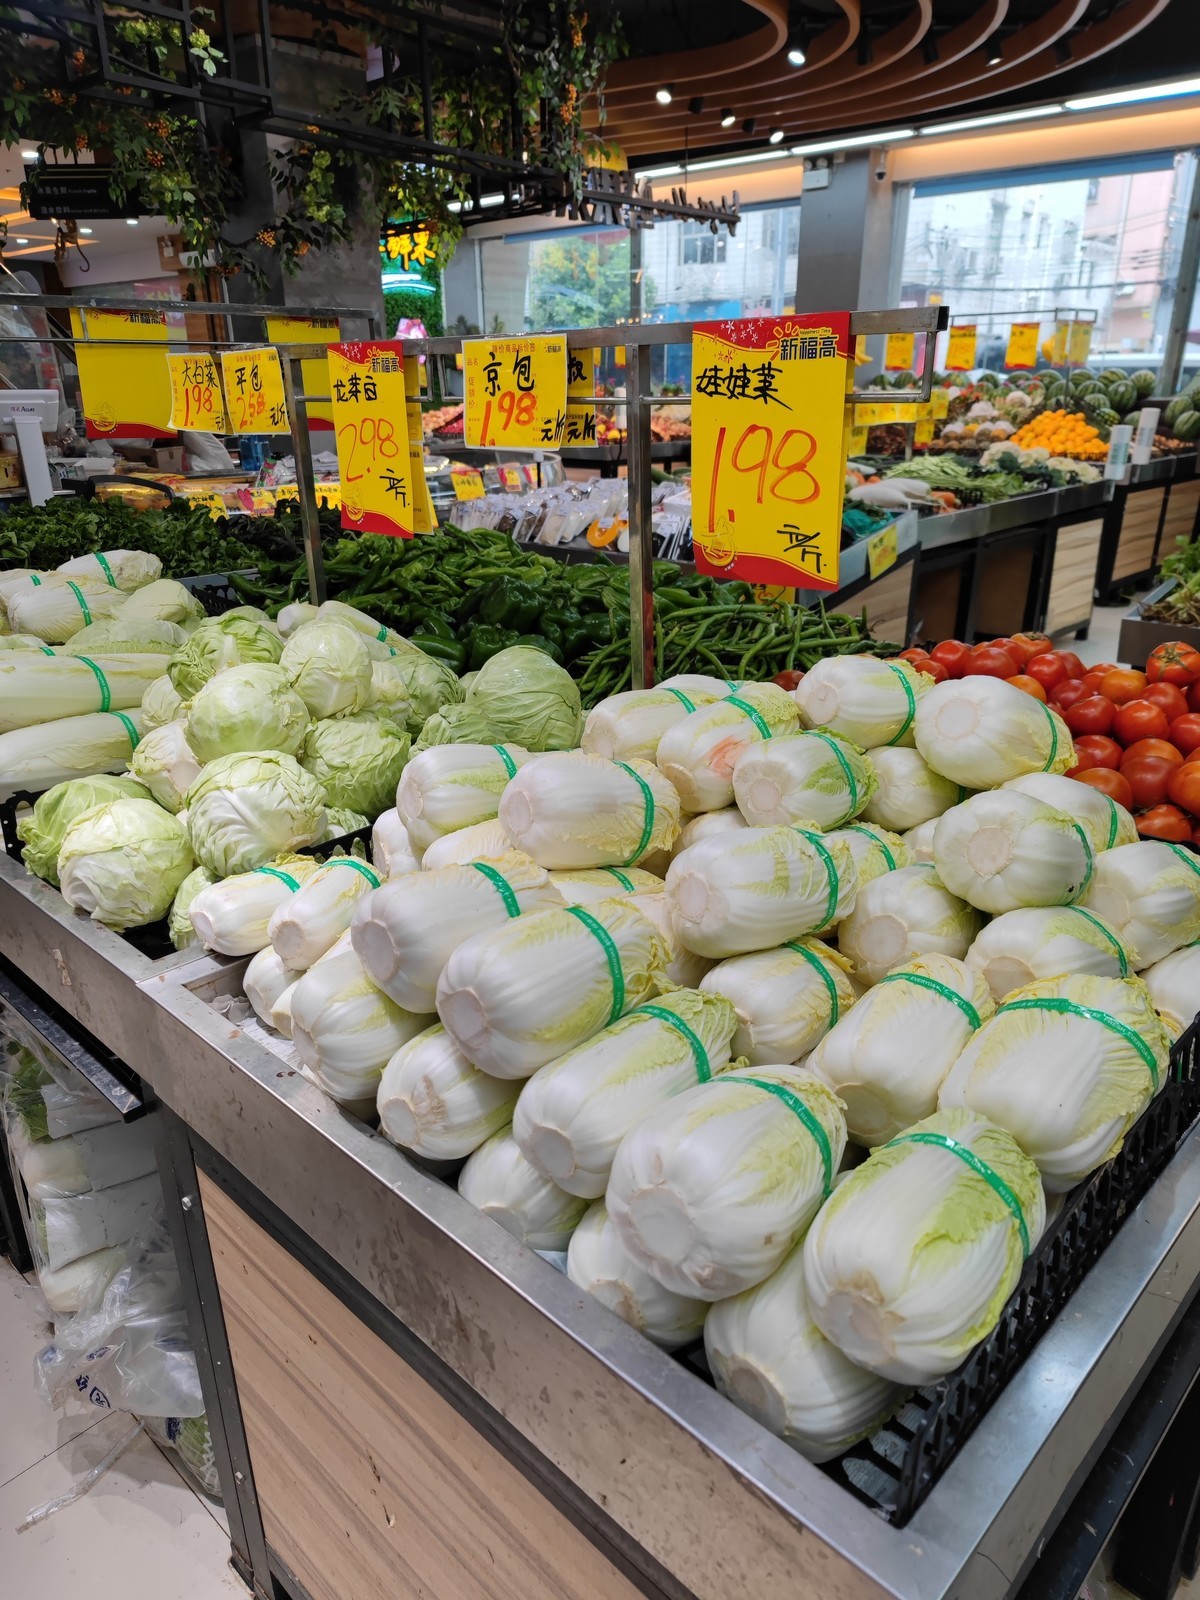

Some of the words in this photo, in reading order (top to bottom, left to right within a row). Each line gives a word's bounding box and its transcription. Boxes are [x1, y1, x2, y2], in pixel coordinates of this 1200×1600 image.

[379, 231, 436, 270] 鲜果
[371, 357, 399, 373] 新福高
[781, 336, 838, 360] 新福高
[182, 360, 219, 388] 大白菜
[235, 361, 262, 395] 平包
[483, 350, 534, 397] 京包
[695, 361, 793, 411] 娃娃菜
[184, 385, 213, 427] 1.98
[480, 390, 537, 447] 1.98
[338, 418, 399, 482] 2.98
[708, 424, 821, 533] 1.98
